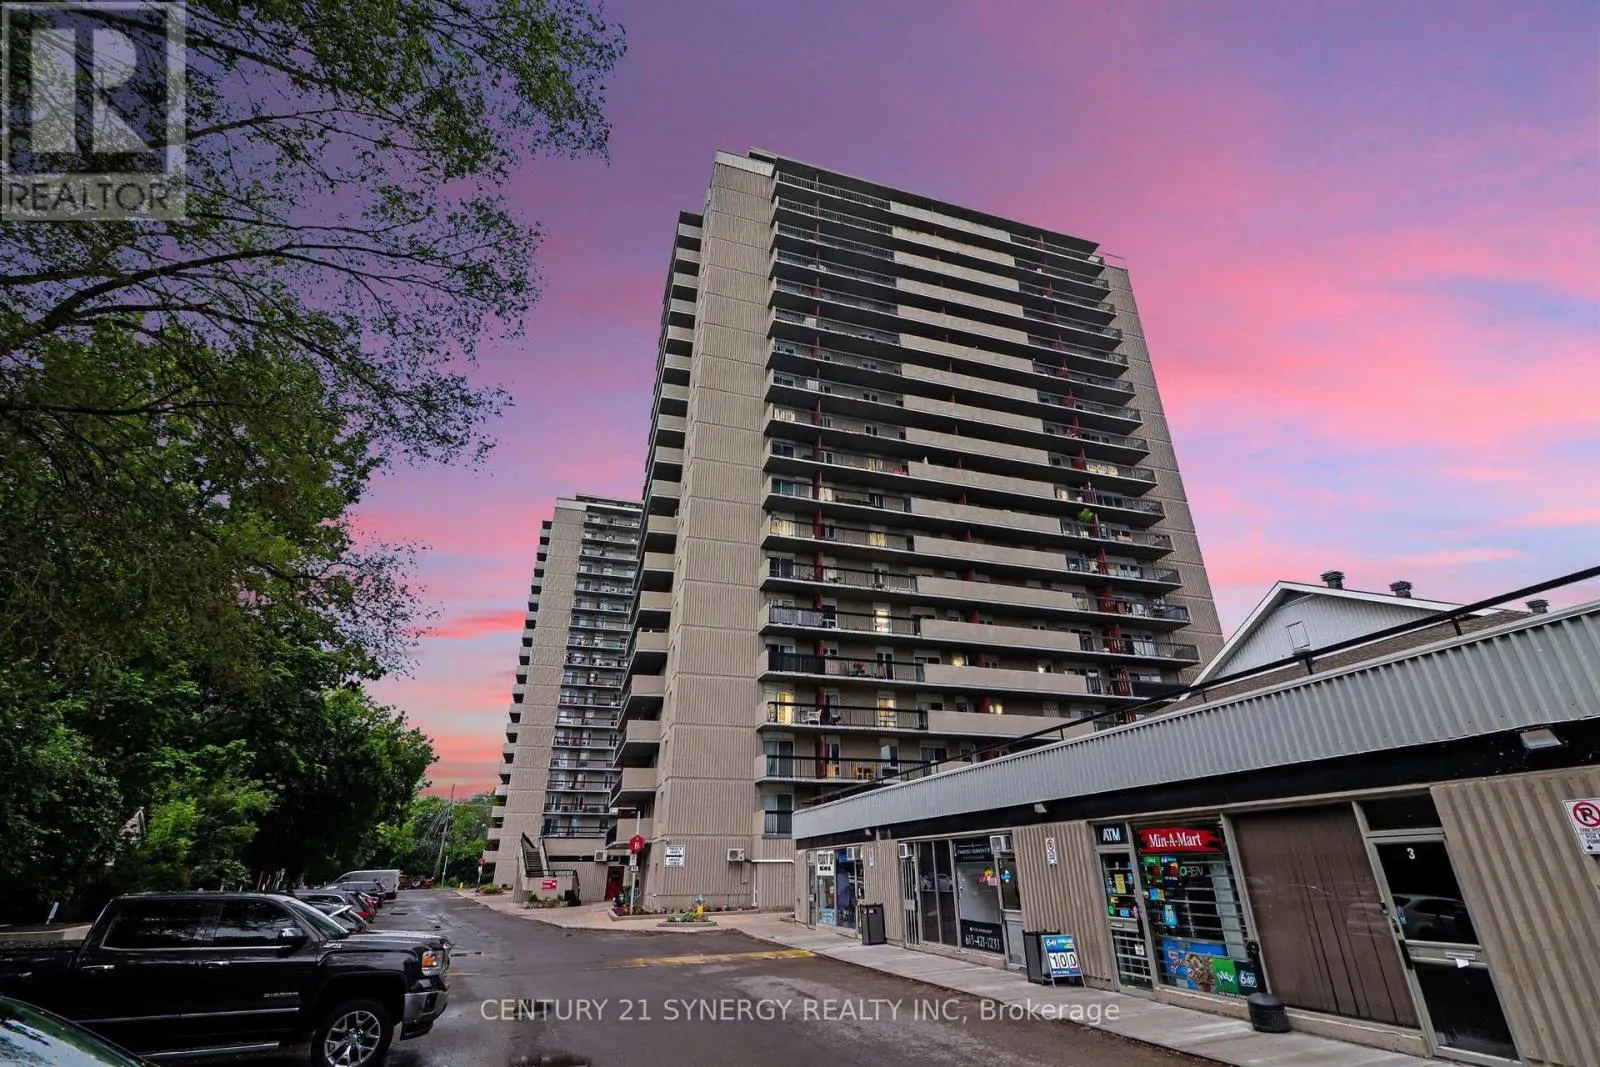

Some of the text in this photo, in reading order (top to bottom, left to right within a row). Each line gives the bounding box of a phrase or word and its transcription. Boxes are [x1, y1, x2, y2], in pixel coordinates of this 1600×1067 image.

[1103, 827, 1121, 842] ATM
[1149, 831, 1202, 848] Min-A-Mart
[1406, 847, 1416, 860] 3
[1180, 866, 1203, 878] OPEN
